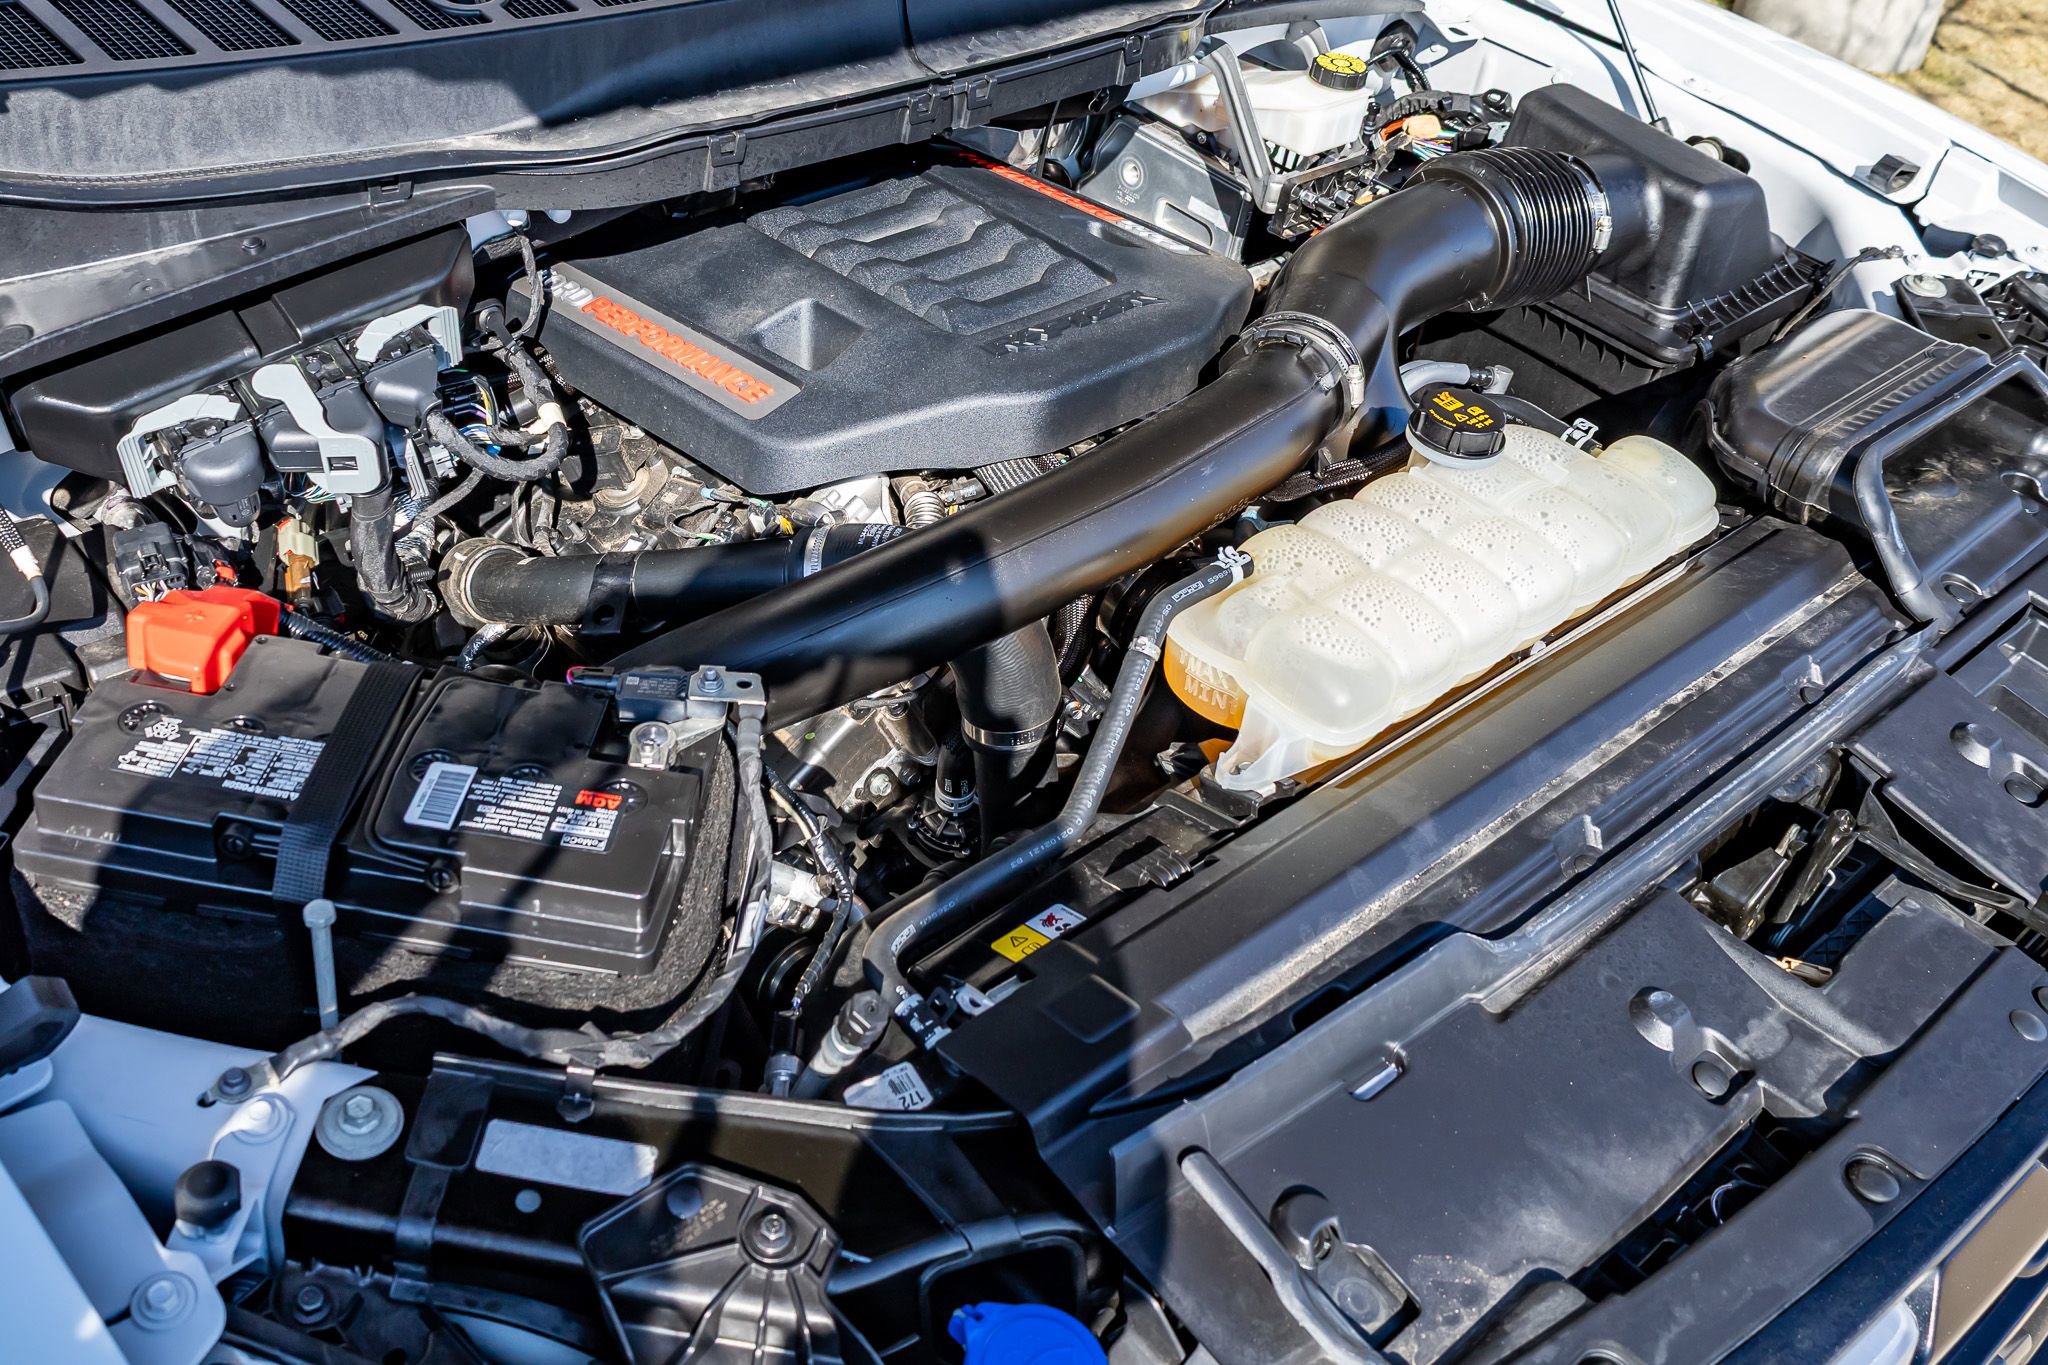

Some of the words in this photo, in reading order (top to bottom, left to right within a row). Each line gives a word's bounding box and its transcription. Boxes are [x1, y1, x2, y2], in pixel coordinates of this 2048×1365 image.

[582, 296, 775, 404] PERFORMANCE
[1183, 674, 1228, 710] MIN
[574, 792, 622, 809] AGM
[560, 832, 606, 851] FoMoCo
[898, 1090, 926, 1111] 172
